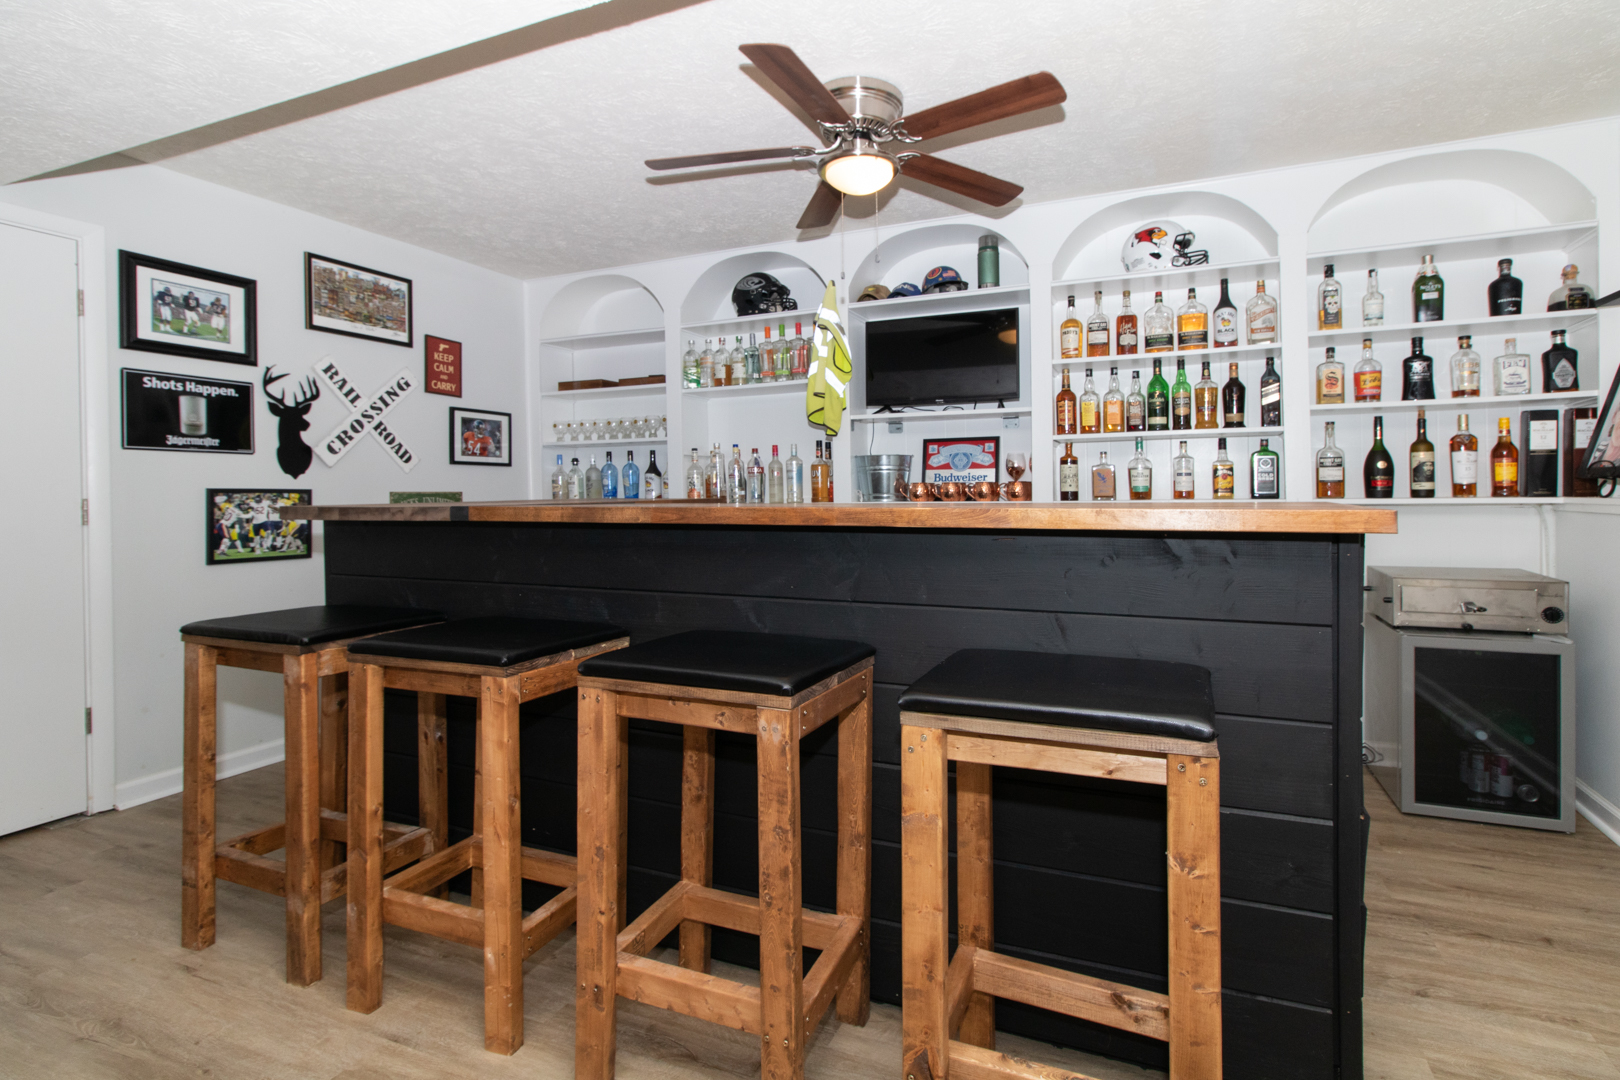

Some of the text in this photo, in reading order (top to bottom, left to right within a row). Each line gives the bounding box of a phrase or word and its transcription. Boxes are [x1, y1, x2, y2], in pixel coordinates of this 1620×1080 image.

[433, 351, 454, 363] KEEP
[433, 363, 454, 374] CALM
[142, 376, 239, 397] Shots Happen.
[321, 362, 362, 408] RAIL
[431, 380, 456, 392] CARRY
[326, 376, 412, 455] CROSSING
[372, 420, 412, 464] ROAD
[467, 440, 481, 456] 54
[934, 472, 988, 482] Budweiser
